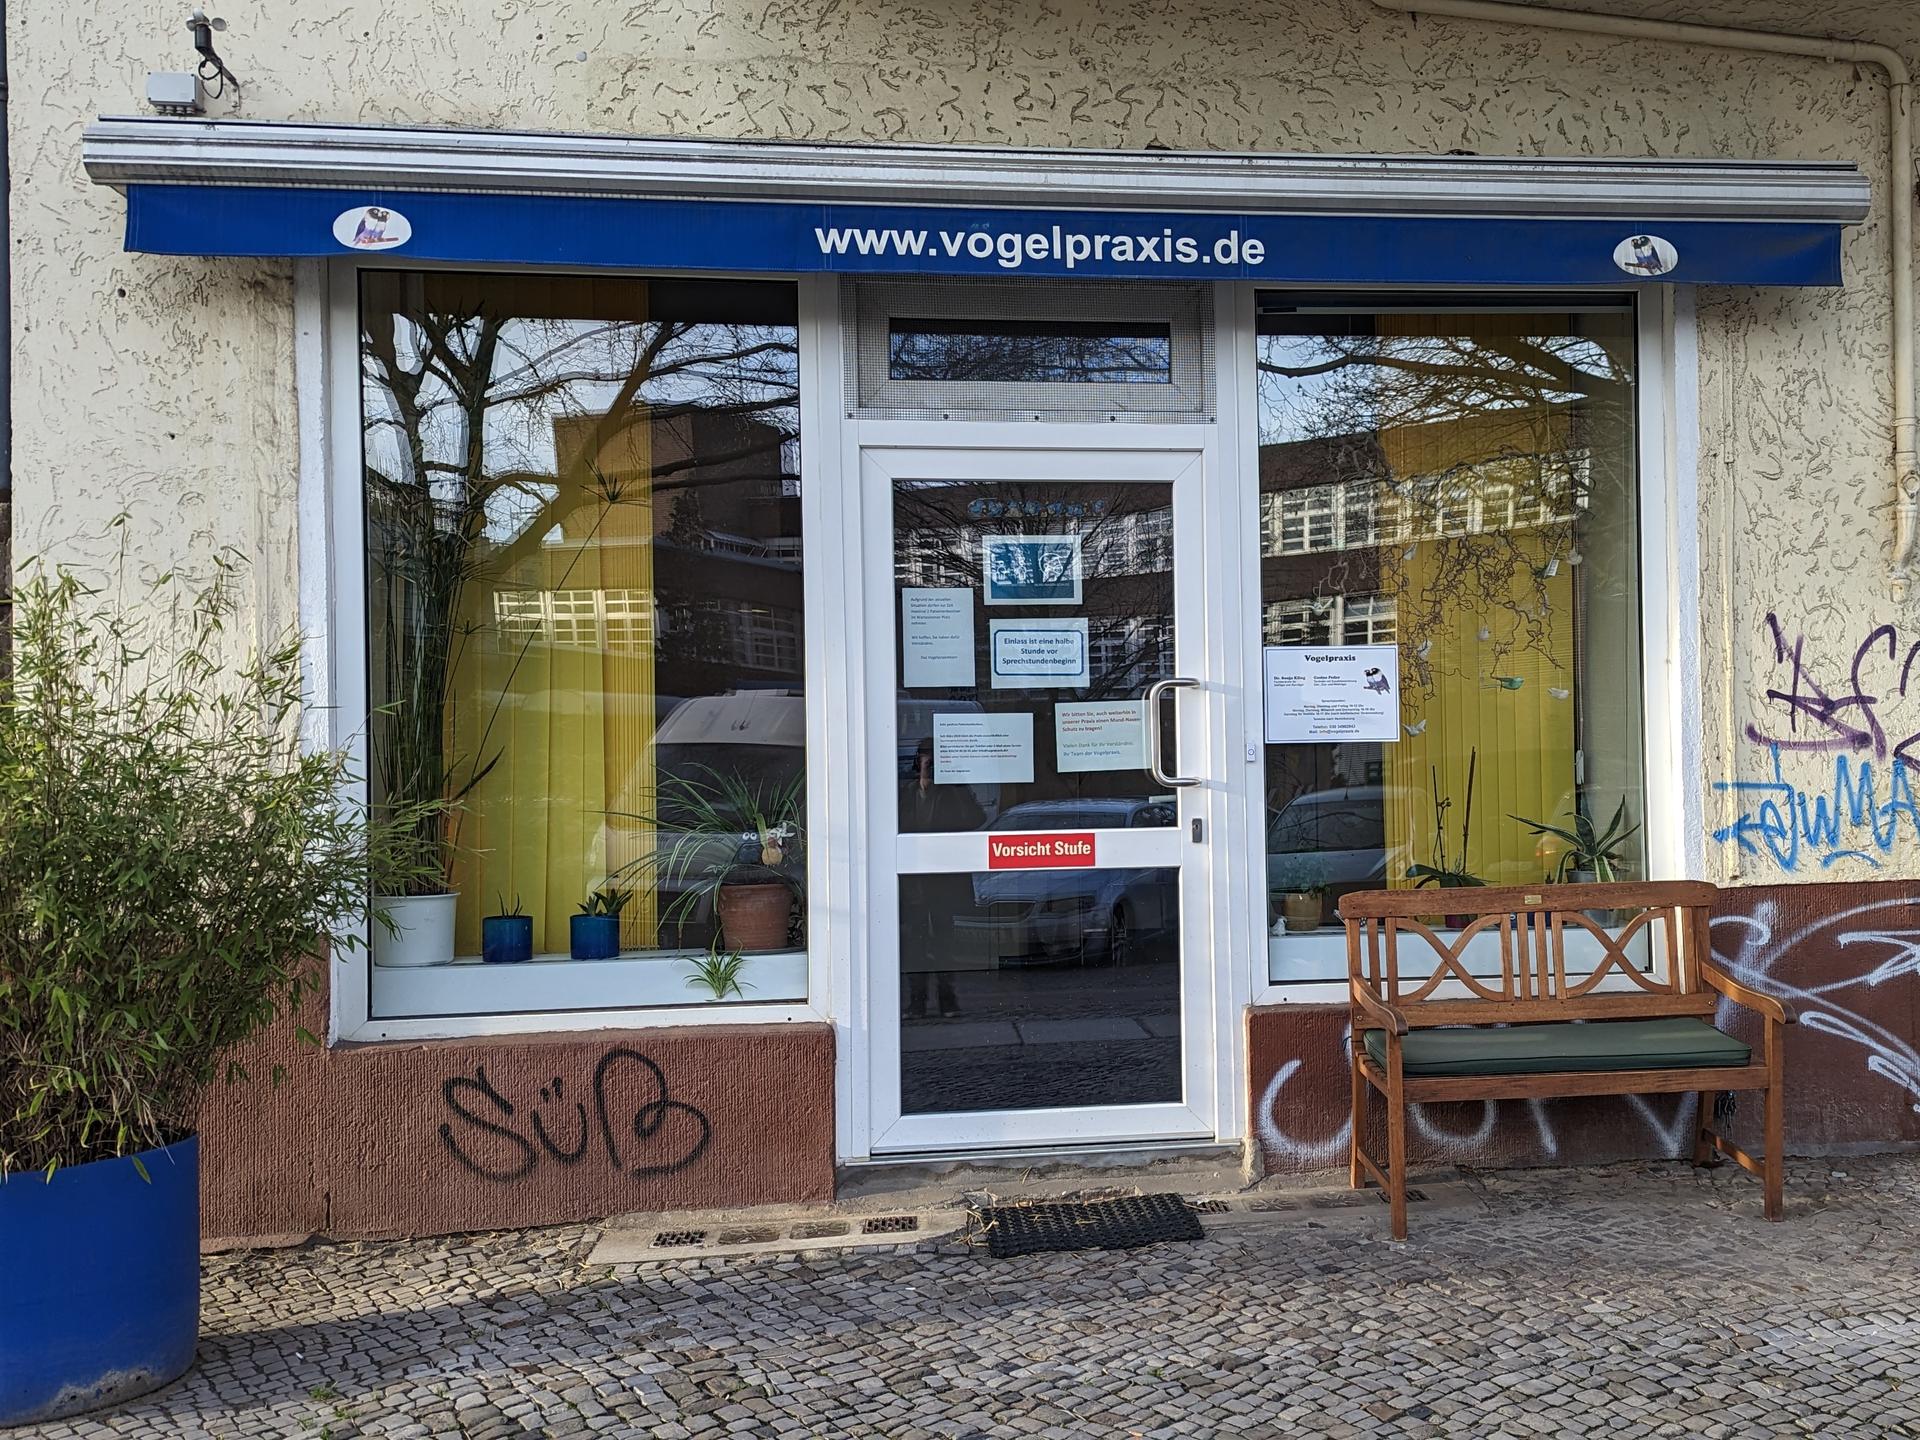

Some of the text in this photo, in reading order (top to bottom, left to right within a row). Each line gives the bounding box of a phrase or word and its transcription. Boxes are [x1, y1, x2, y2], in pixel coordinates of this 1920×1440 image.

[1304, 654, 1356, 663] Vogelpraxis
[992, 840, 1091, 857] Vorsicht Stufe
